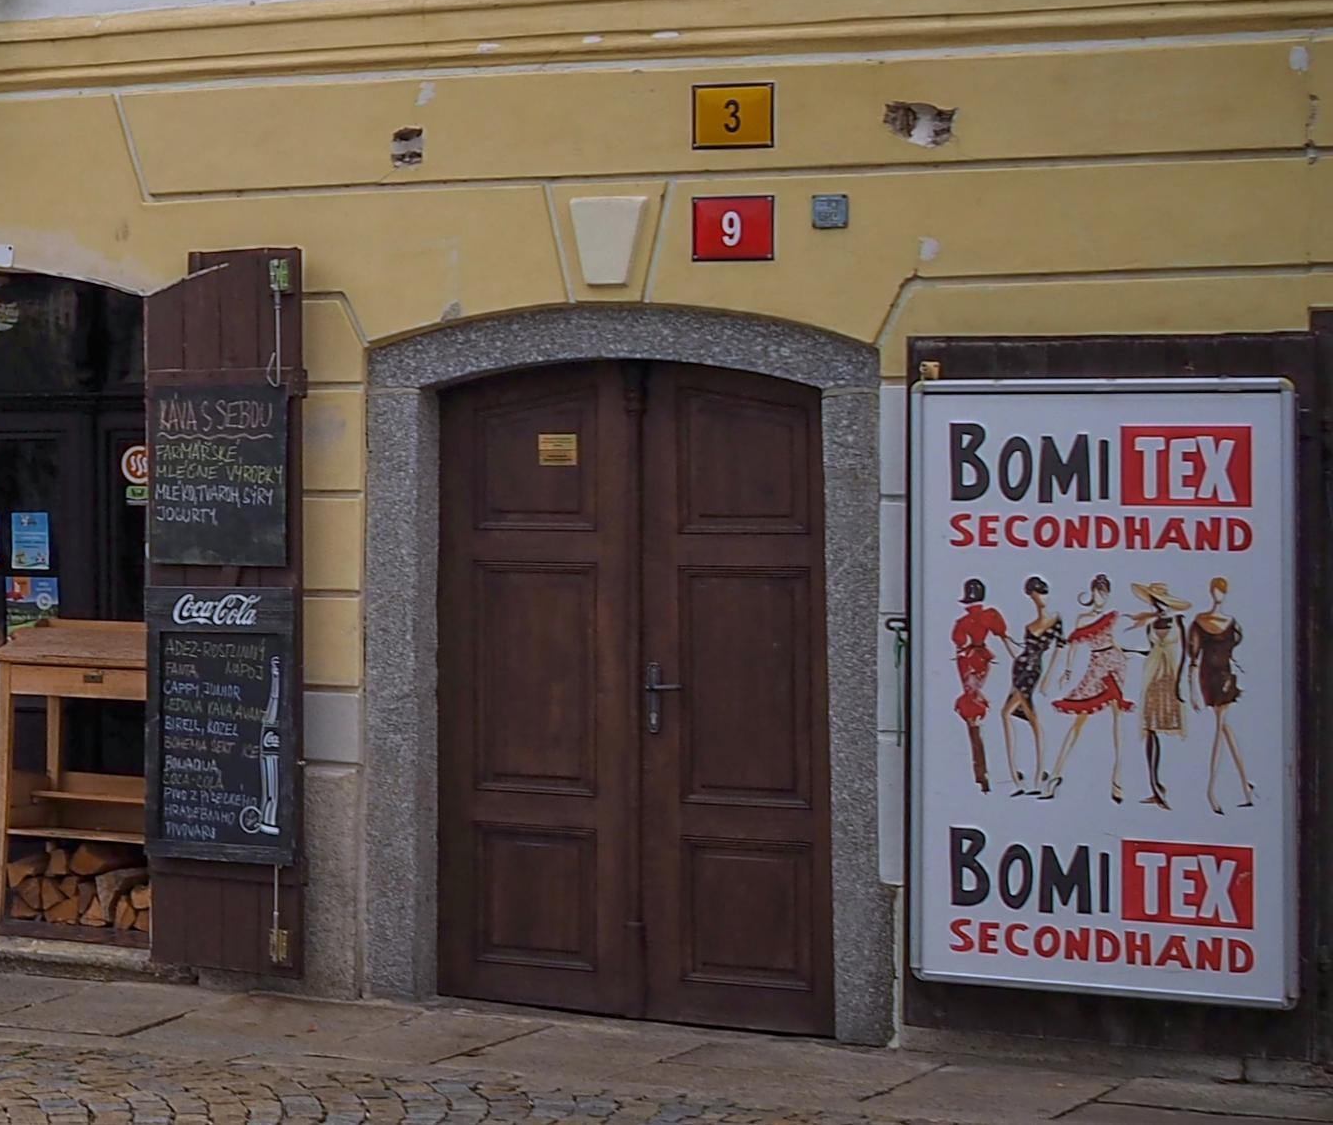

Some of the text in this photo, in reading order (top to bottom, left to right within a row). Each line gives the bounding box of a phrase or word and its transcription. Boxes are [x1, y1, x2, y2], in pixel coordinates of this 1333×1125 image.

[723, 99, 742, 134] 3
[721, 210, 742, 248] 9
[158, 392, 198, 431] KÁVA
[199, 400, 214, 432] S
[949, 422, 1238, 503] BOMI TEX
[948, 512, 1253, 552] SECONDHAND
[172, 593, 262, 626] Coca-Cola
[949, 825, 1239, 924] BOMI TEX
[948, 918, 1255, 974] SECONDHAND
